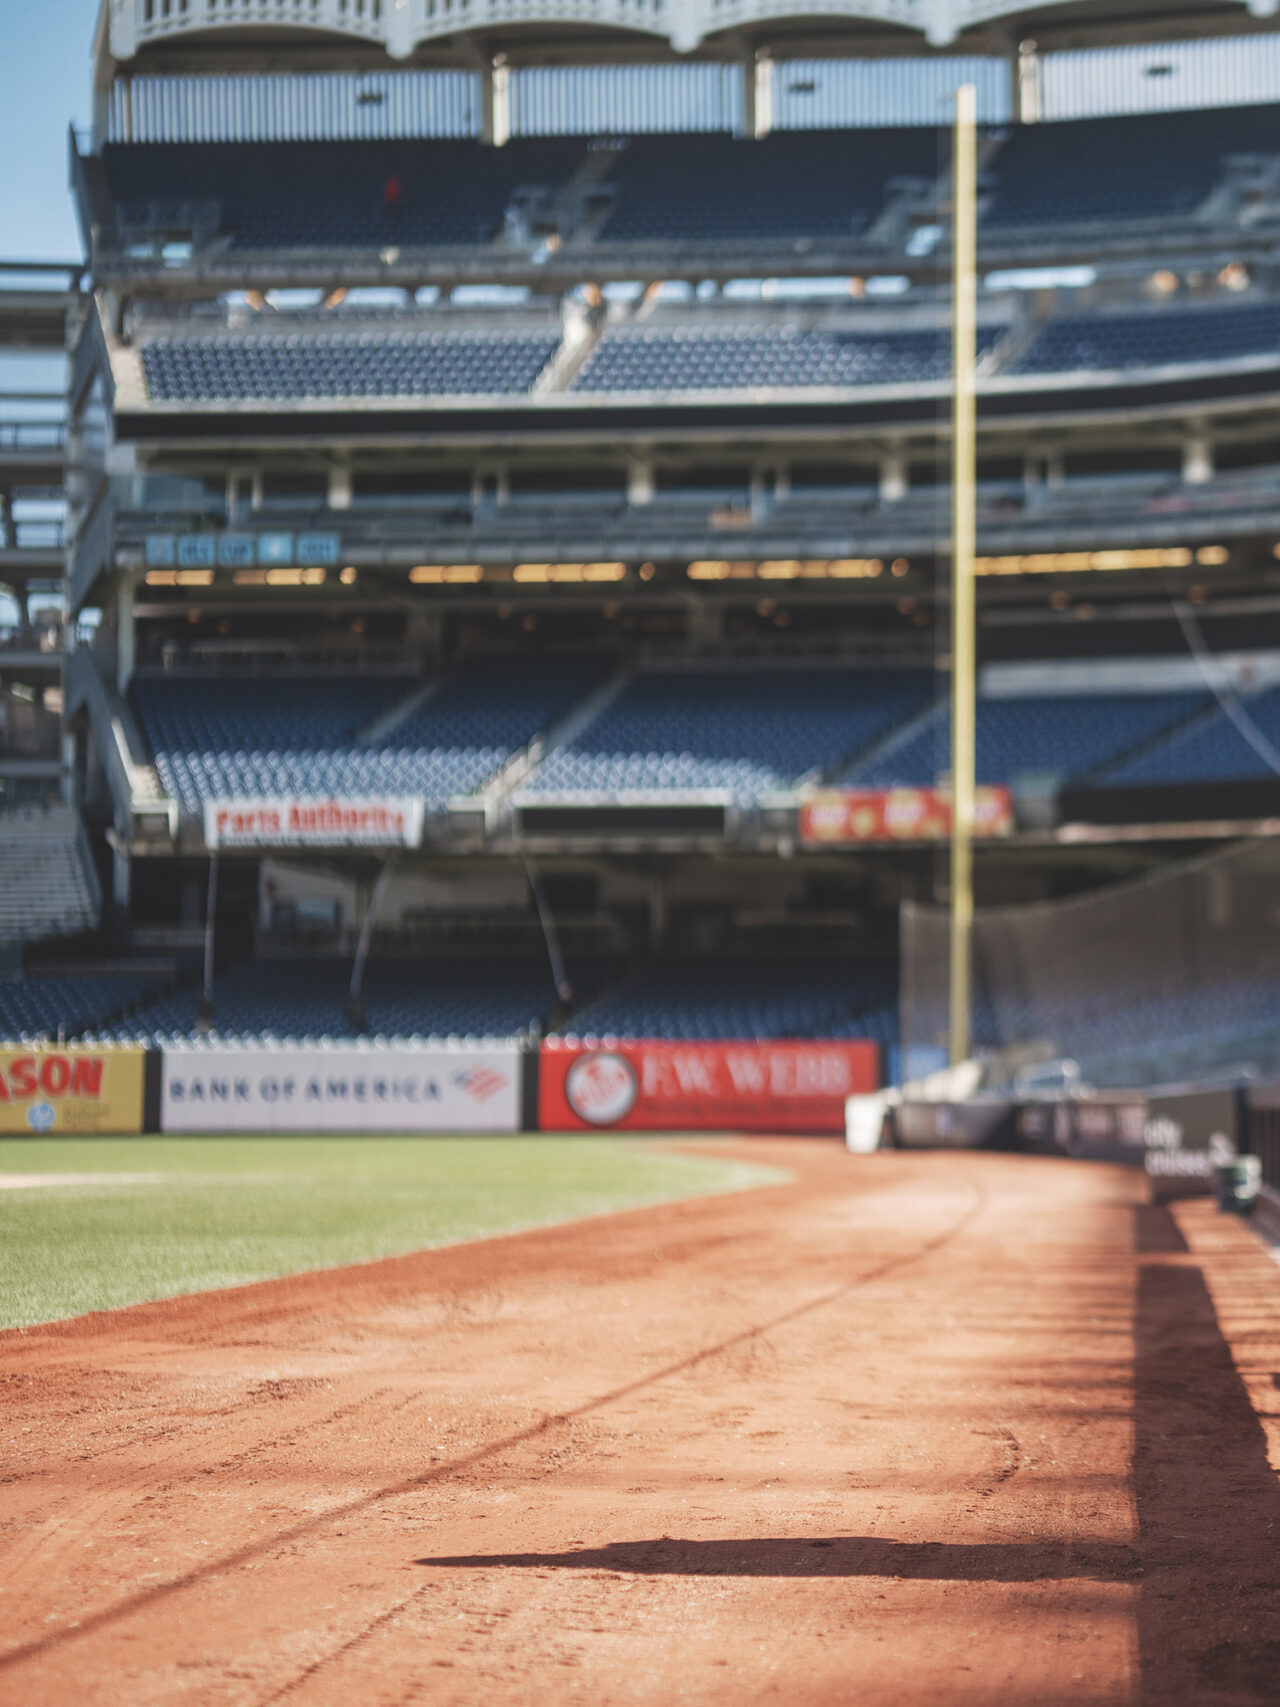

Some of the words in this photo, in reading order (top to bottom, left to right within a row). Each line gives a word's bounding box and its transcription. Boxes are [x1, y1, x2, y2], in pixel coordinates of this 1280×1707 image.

[217, 808, 280, 833] Parts
[289, 803, 404, 834] Authority
[169, 1076, 251, 1103] BANK
[260, 1075, 295, 1103] OF
[305, 1075, 442, 1103] AMERICA
[726, 1053, 852, 1096] WEBB
